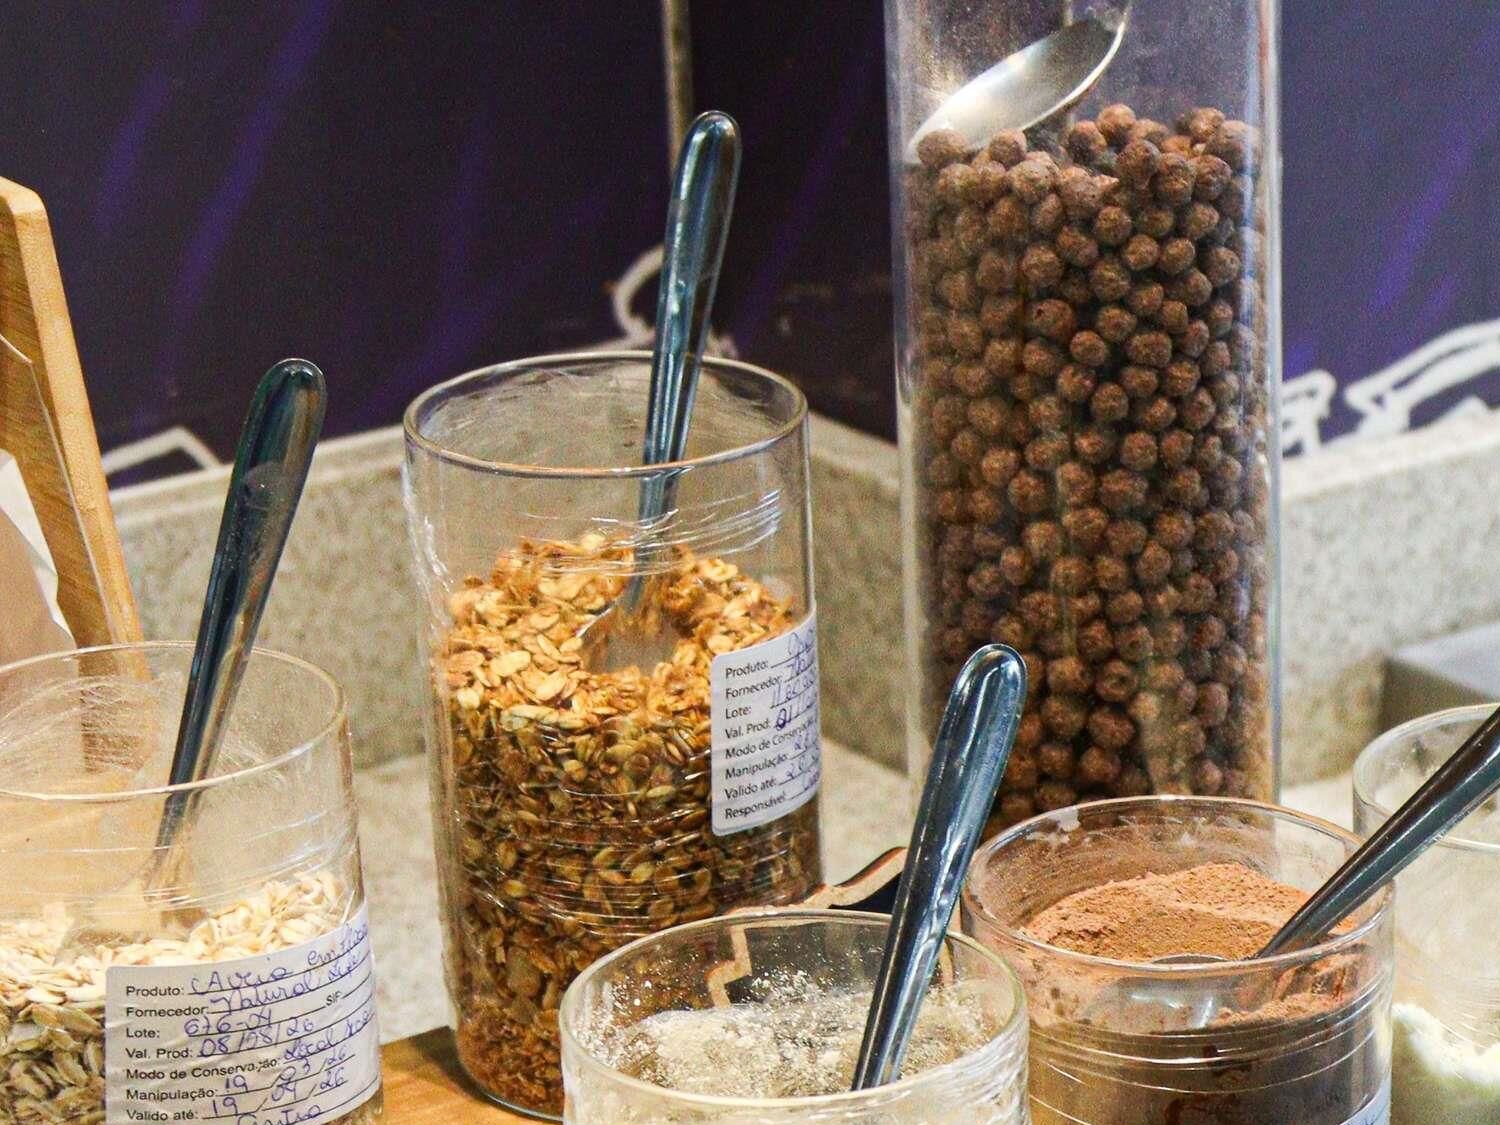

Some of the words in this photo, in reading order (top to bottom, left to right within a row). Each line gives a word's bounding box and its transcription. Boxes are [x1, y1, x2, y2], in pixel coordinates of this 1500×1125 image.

[725, 660, 769, 679] Produto:
[725, 705, 752, 719] Lote:
[725, 742, 757, 759] Modo
[757, 739, 771, 750] de
[126, 985, 184, 998] Produto:
[126, 1006, 208, 1018] Fornecedor:
[126, 1028, 160, 1039] Lote:
[156, 1048, 193, 1060] Prod:
[126, 1069, 165, 1081] Modo
[170, 1068, 188, 1079] de
[126, 1088, 219, 1102] Manipulação:
[126, 1109, 168, 1121] Valido
[173, 1107, 199, 1120] até:
